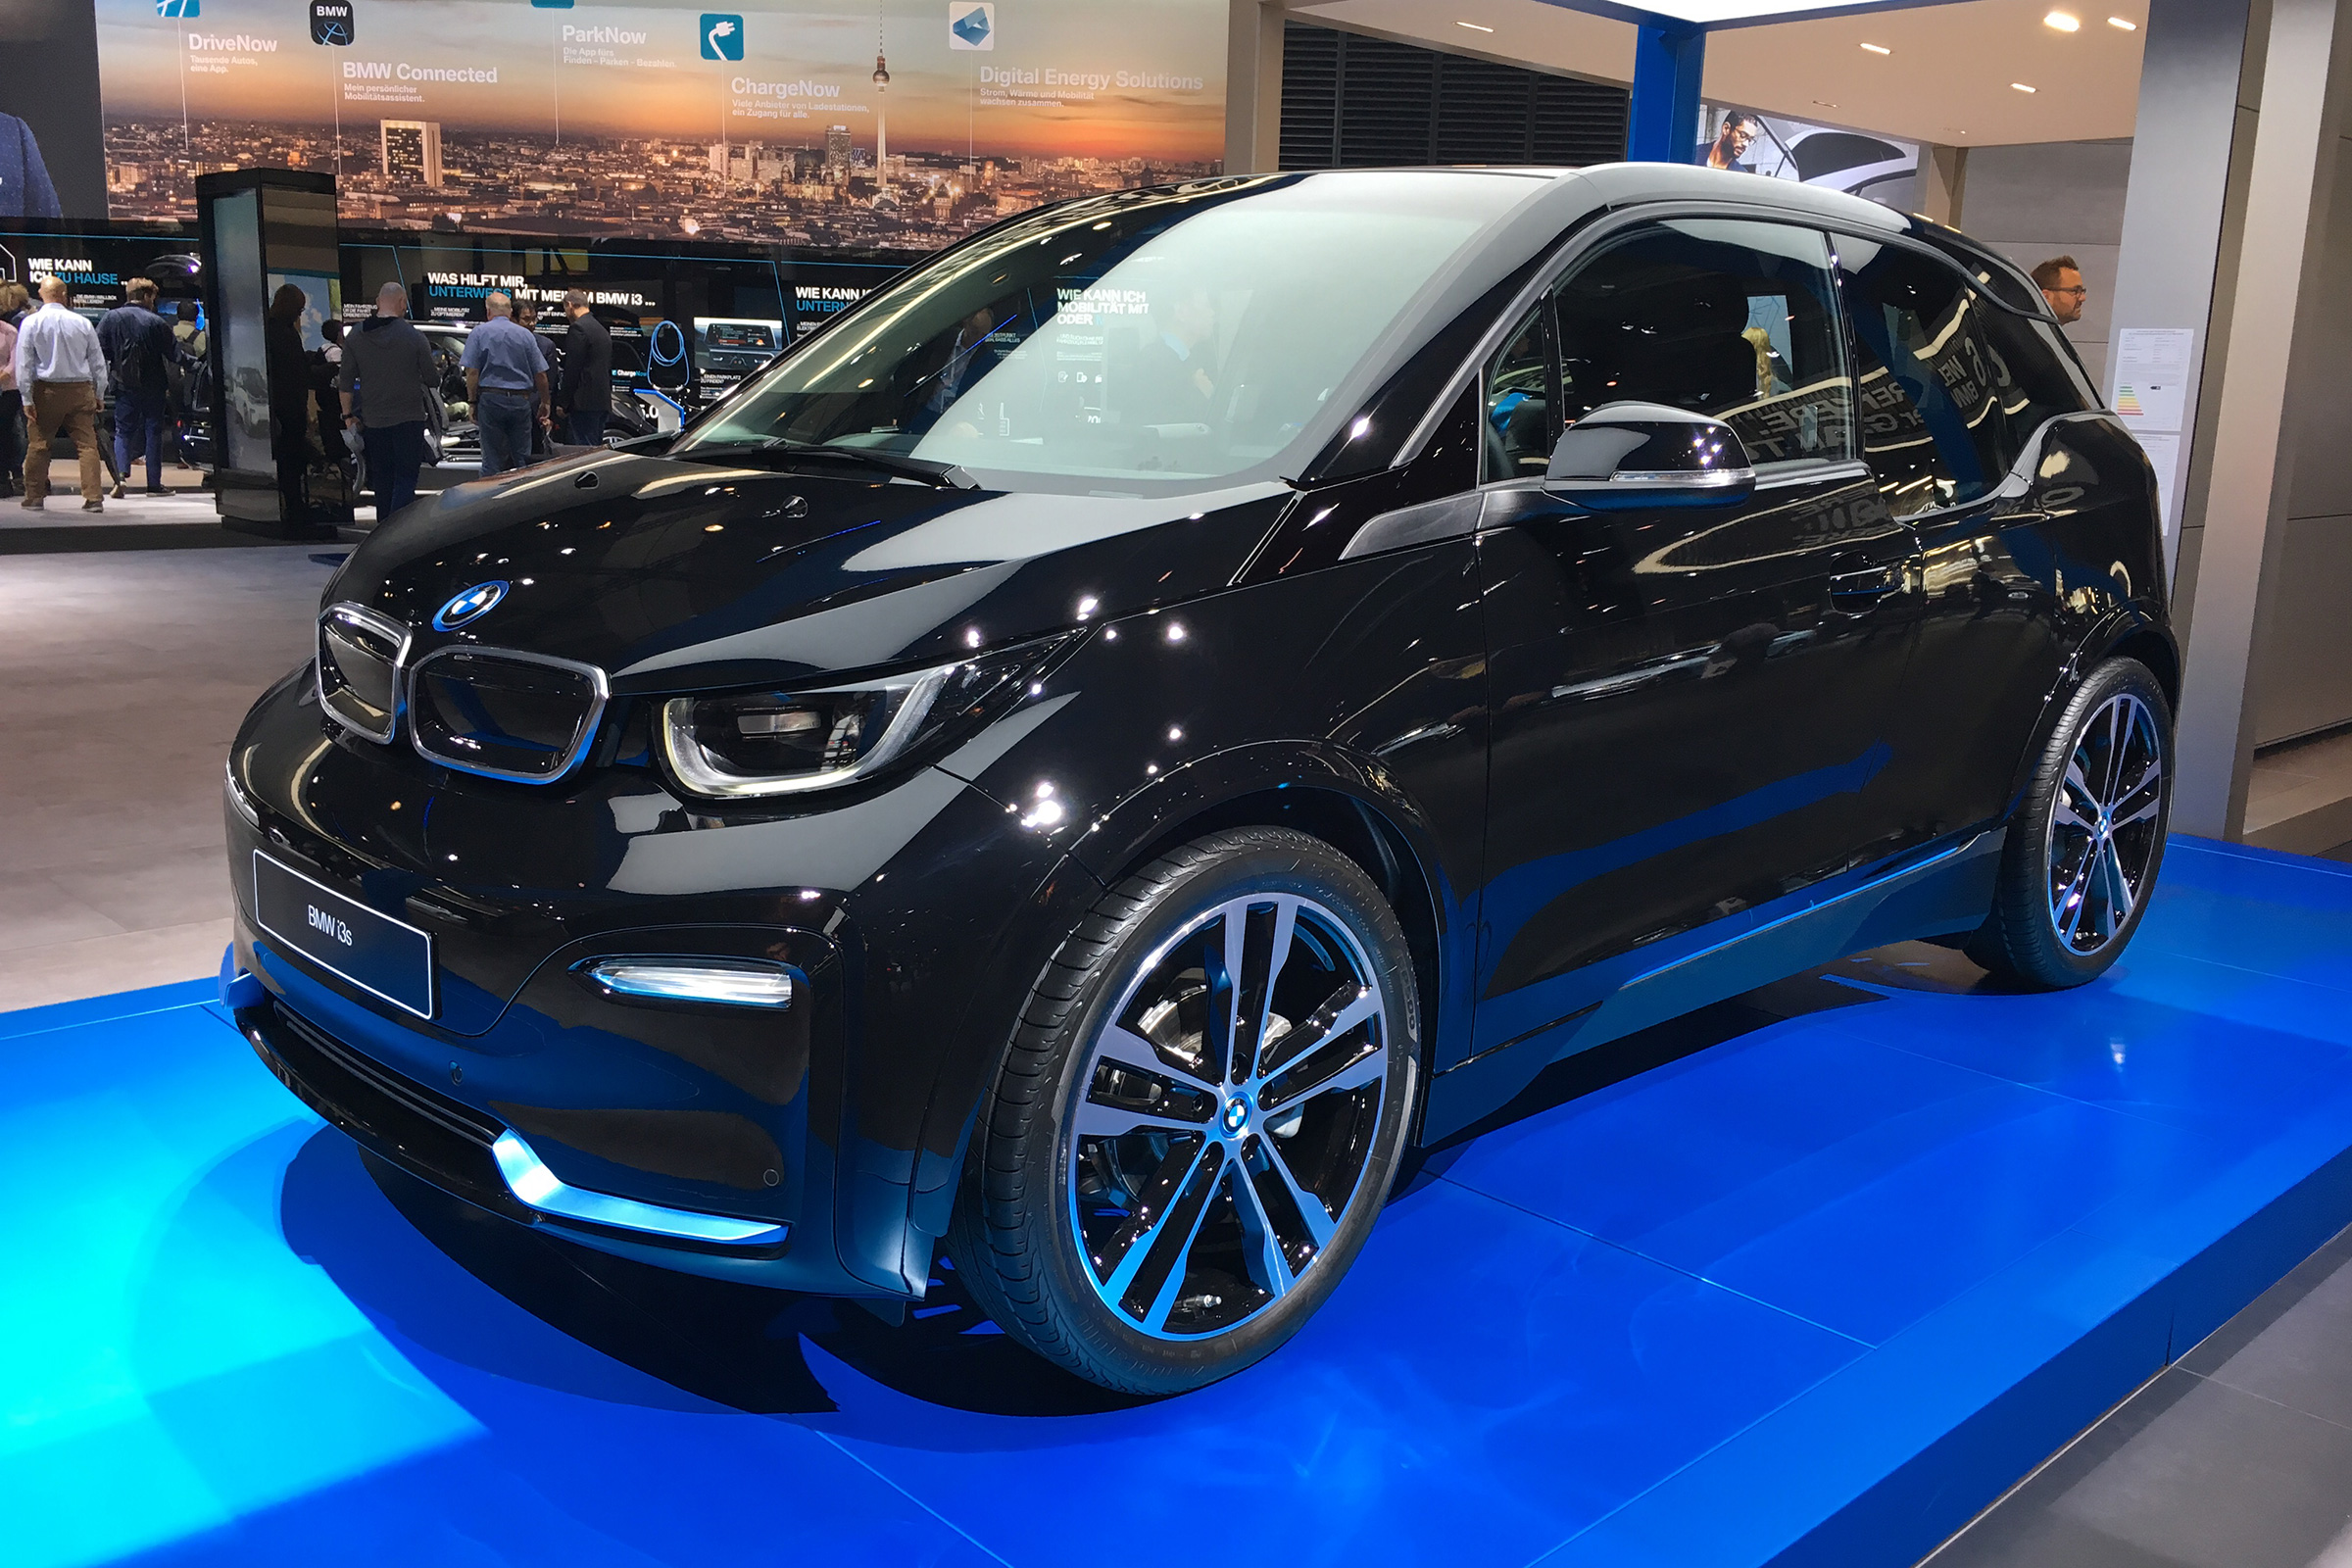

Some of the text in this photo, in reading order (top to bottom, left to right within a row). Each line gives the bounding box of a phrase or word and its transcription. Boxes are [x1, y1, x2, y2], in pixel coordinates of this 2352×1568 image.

[317, 6, 348, 17] BMW
[563, 24, 647, 44] ParkNow
[188, 33, 277, 52] DriveNow
[578, 48, 596, 57] App
[190, 55, 258, 67] Tausende Autos,
[564, 56, 592, 65] Finden
[600, 57, 628, 66] Parken
[190, 64, 228, 74] eine App.
[343, 62, 497, 83] BMW Connected
[980, 66, 1203, 90] Digital Energy Solutions
[344, 83, 417, 94] Mein persönlicher
[731, 76, 840, 99] ChargeNow
[980, 87, 1008, 97] Strom,
[1009, 89, 1039, 98] Wärme
[1057, 90, 1095, 100] Mobilität
[344, 92, 425, 103] Mobilitätsassistent.
[755, 100, 790, 109] Anbieter
[808, 102, 870, 113] Ladestationen,
[747, 109, 778, 119] Zugang
[27, 258, 92, 272] WIE KANN
[74, 272, 119, 285] HAUSE
[427, 272, 527, 289] WAS HILFT MIR,
[514, 288, 540, 301] MIT
[597, 292, 630, 306] BMW
[631, 293, 643, 306] i3
[795, 286, 820, 299] WIE
[822, 287, 859, 301] KANN
[1056, 288, 1147, 303] WIE KANN ICH
[1057, 301, 1150, 315] MOBILITÄT MIT
[1056, 314, 1094, 325] ODER
[308, 905, 353, 947] BMW i3s
